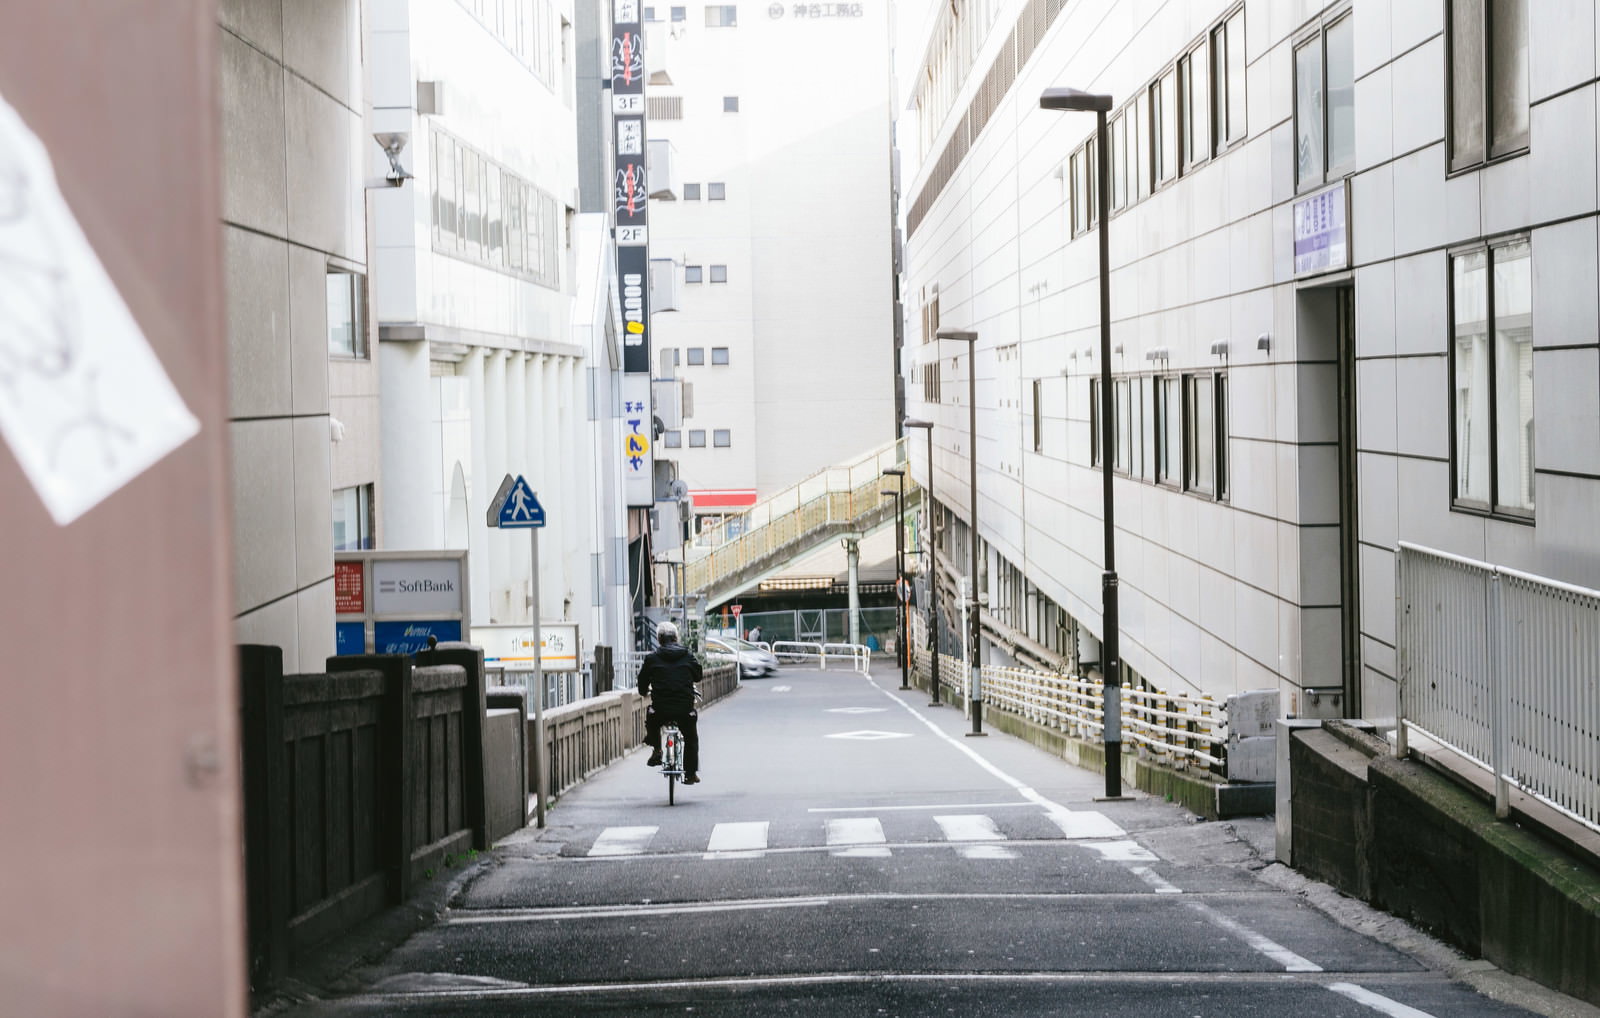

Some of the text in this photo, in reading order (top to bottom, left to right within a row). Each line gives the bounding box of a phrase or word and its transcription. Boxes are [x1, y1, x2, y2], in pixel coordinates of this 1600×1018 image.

[619, 97, 638, 109] 3F
[622, 229, 641, 240] 2F
[624, 273, 644, 346] DOUTOR
[627, 419, 643, 471] てんや
[399, 580, 454, 592] SoftBank
